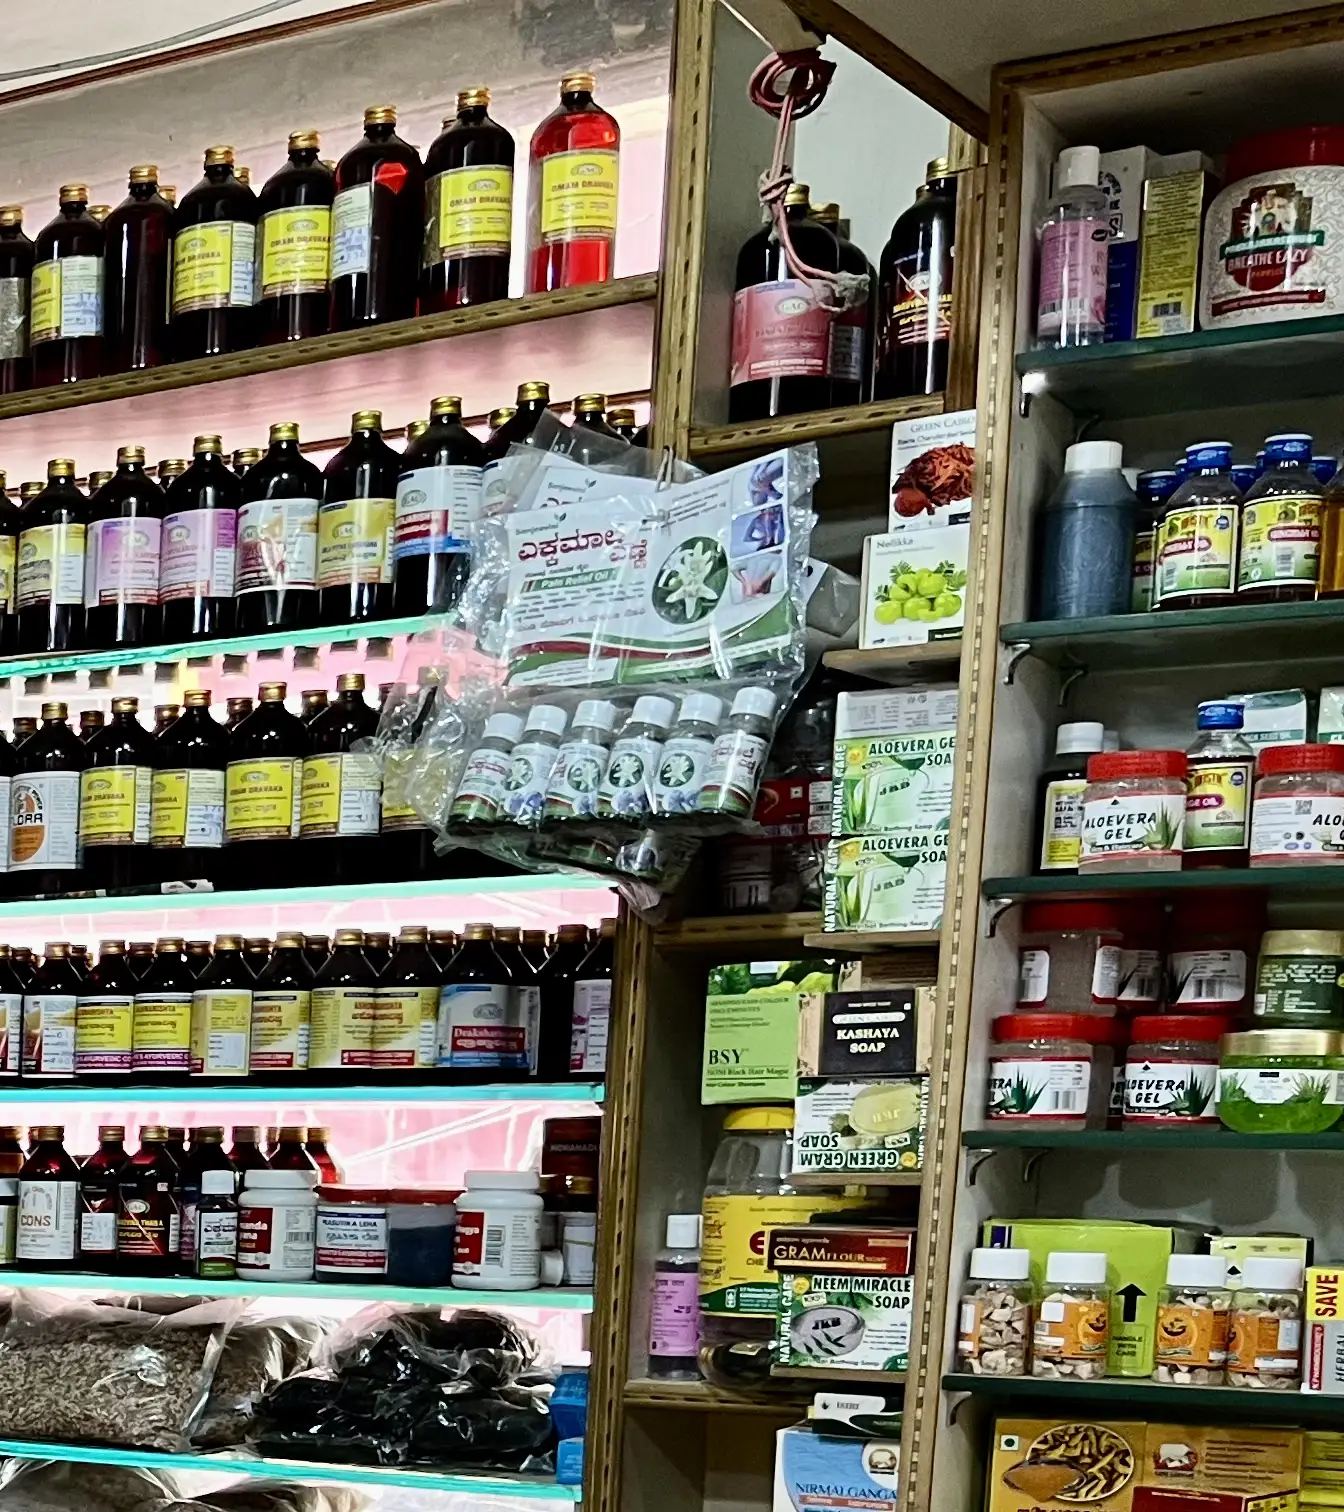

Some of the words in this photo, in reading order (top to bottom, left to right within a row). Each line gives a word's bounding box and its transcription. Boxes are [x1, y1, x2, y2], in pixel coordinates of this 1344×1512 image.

[1228, 253, 1275, 272] BREATHE
[1276, 248, 1308, 264] EAZY
[540, 578, 564, 590] Pain
[565, 575, 593, 588] Relief
[595, 573, 610, 584] Oil
[868, 738, 935, 756] ALOEVERA
[834, 743, 847, 778] CARE
[926, 752, 953, 767] SOA
[831, 777, 846, 838] NATURAL
[1202, 796, 1220, 808] OIL
[1085, 812, 1158, 829] ALOEVERA
[1104, 826, 1135, 842] GEL
[862, 834, 930, 852] ALOEVERA
[920, 849, 947, 864] SOA
[822, 874, 837, 933] NATURAL
[836, 1027, 900, 1040] KASHAYA
[849, 1042, 885, 1053] SOAP
[708, 1049, 742, 1065] BSY
[1135, 1091, 1163, 1104] GEL
[801, 1133, 839, 1148] SOAP
[800, 1152, 847, 1167] GRAM
[848, 1151, 898, 1167] GREEN
[20, 1213, 51, 1227] CONS
[774, 1245, 826, 1260] GRAM
[782, 1274, 794, 1307] CARE
[813, 1276, 849, 1291] NEEM
[853, 1277, 911, 1293] MIRACLE
[874, 1295, 910, 1309] SOAP
[1315, 1273, 1339, 1319] SAVE
[779, 1308, 792, 1364] NATURAL
[847, 1486, 897, 1501] GANGA
